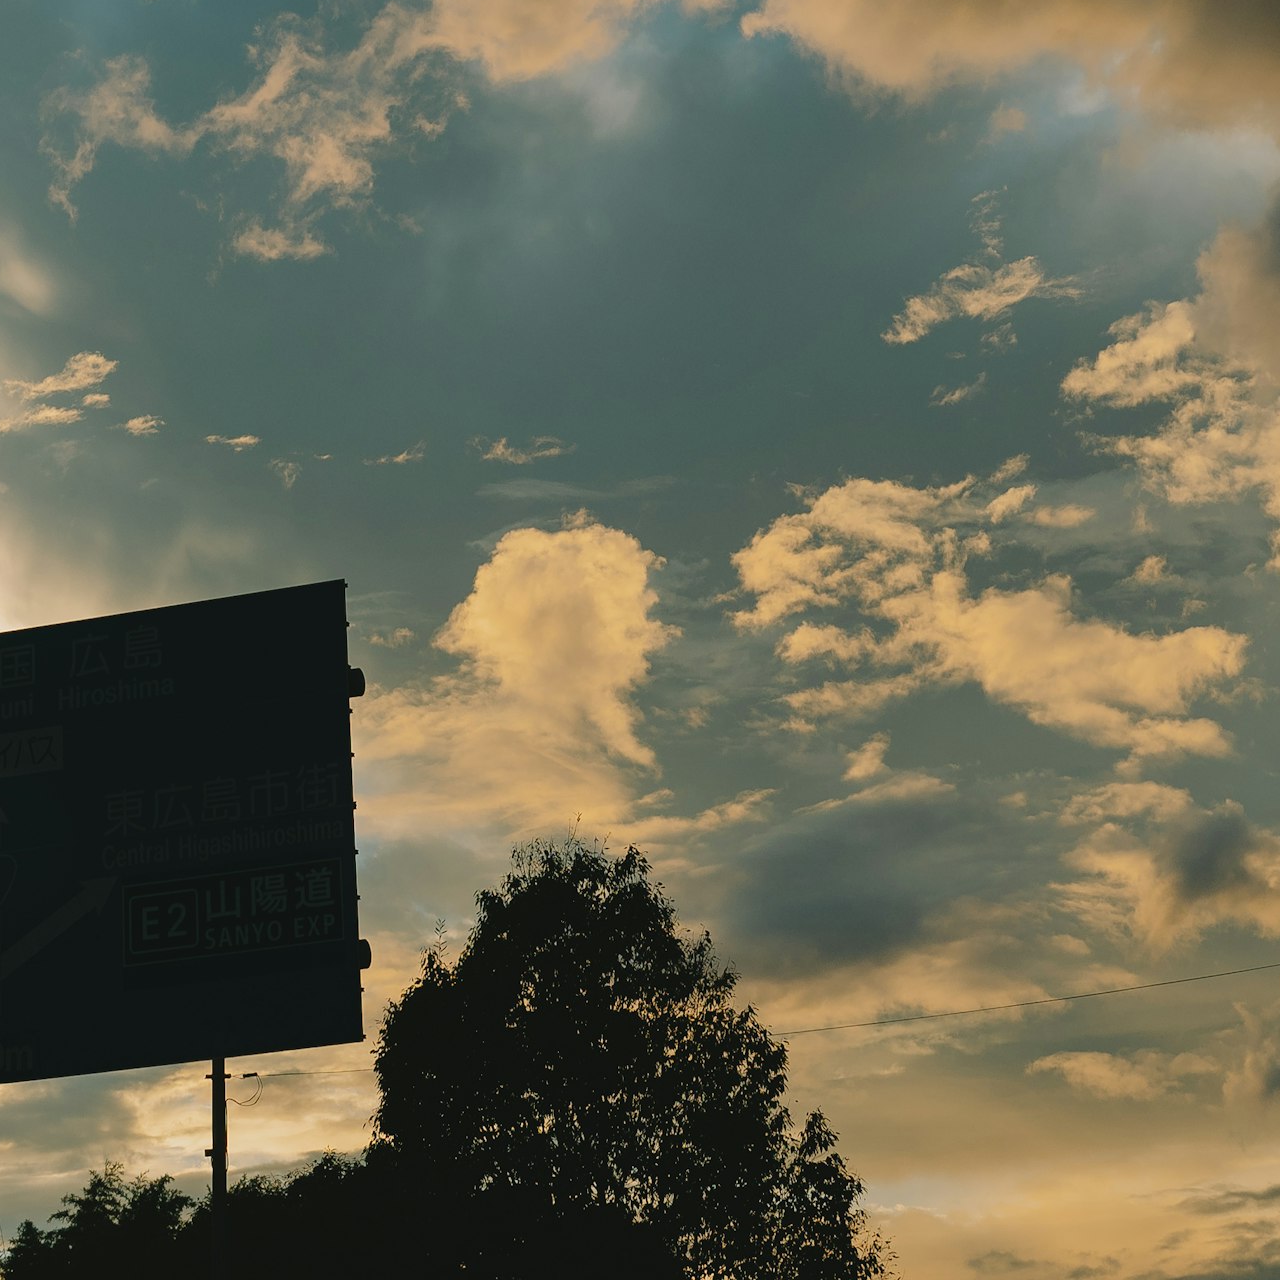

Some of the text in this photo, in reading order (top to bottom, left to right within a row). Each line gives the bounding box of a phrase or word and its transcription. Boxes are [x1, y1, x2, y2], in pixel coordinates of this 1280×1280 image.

[68, 624, 164, 679] 広島
[57, 675, 175, 711] Hiroshima
[102, 762, 341, 838] 東広島市街
[101, 818, 345, 870] Central Higashihiroshima
[204, 867, 335, 922] 山陽道
[142, 902, 187, 941] E2
[204, 914, 335, 950] SANYO EXP
